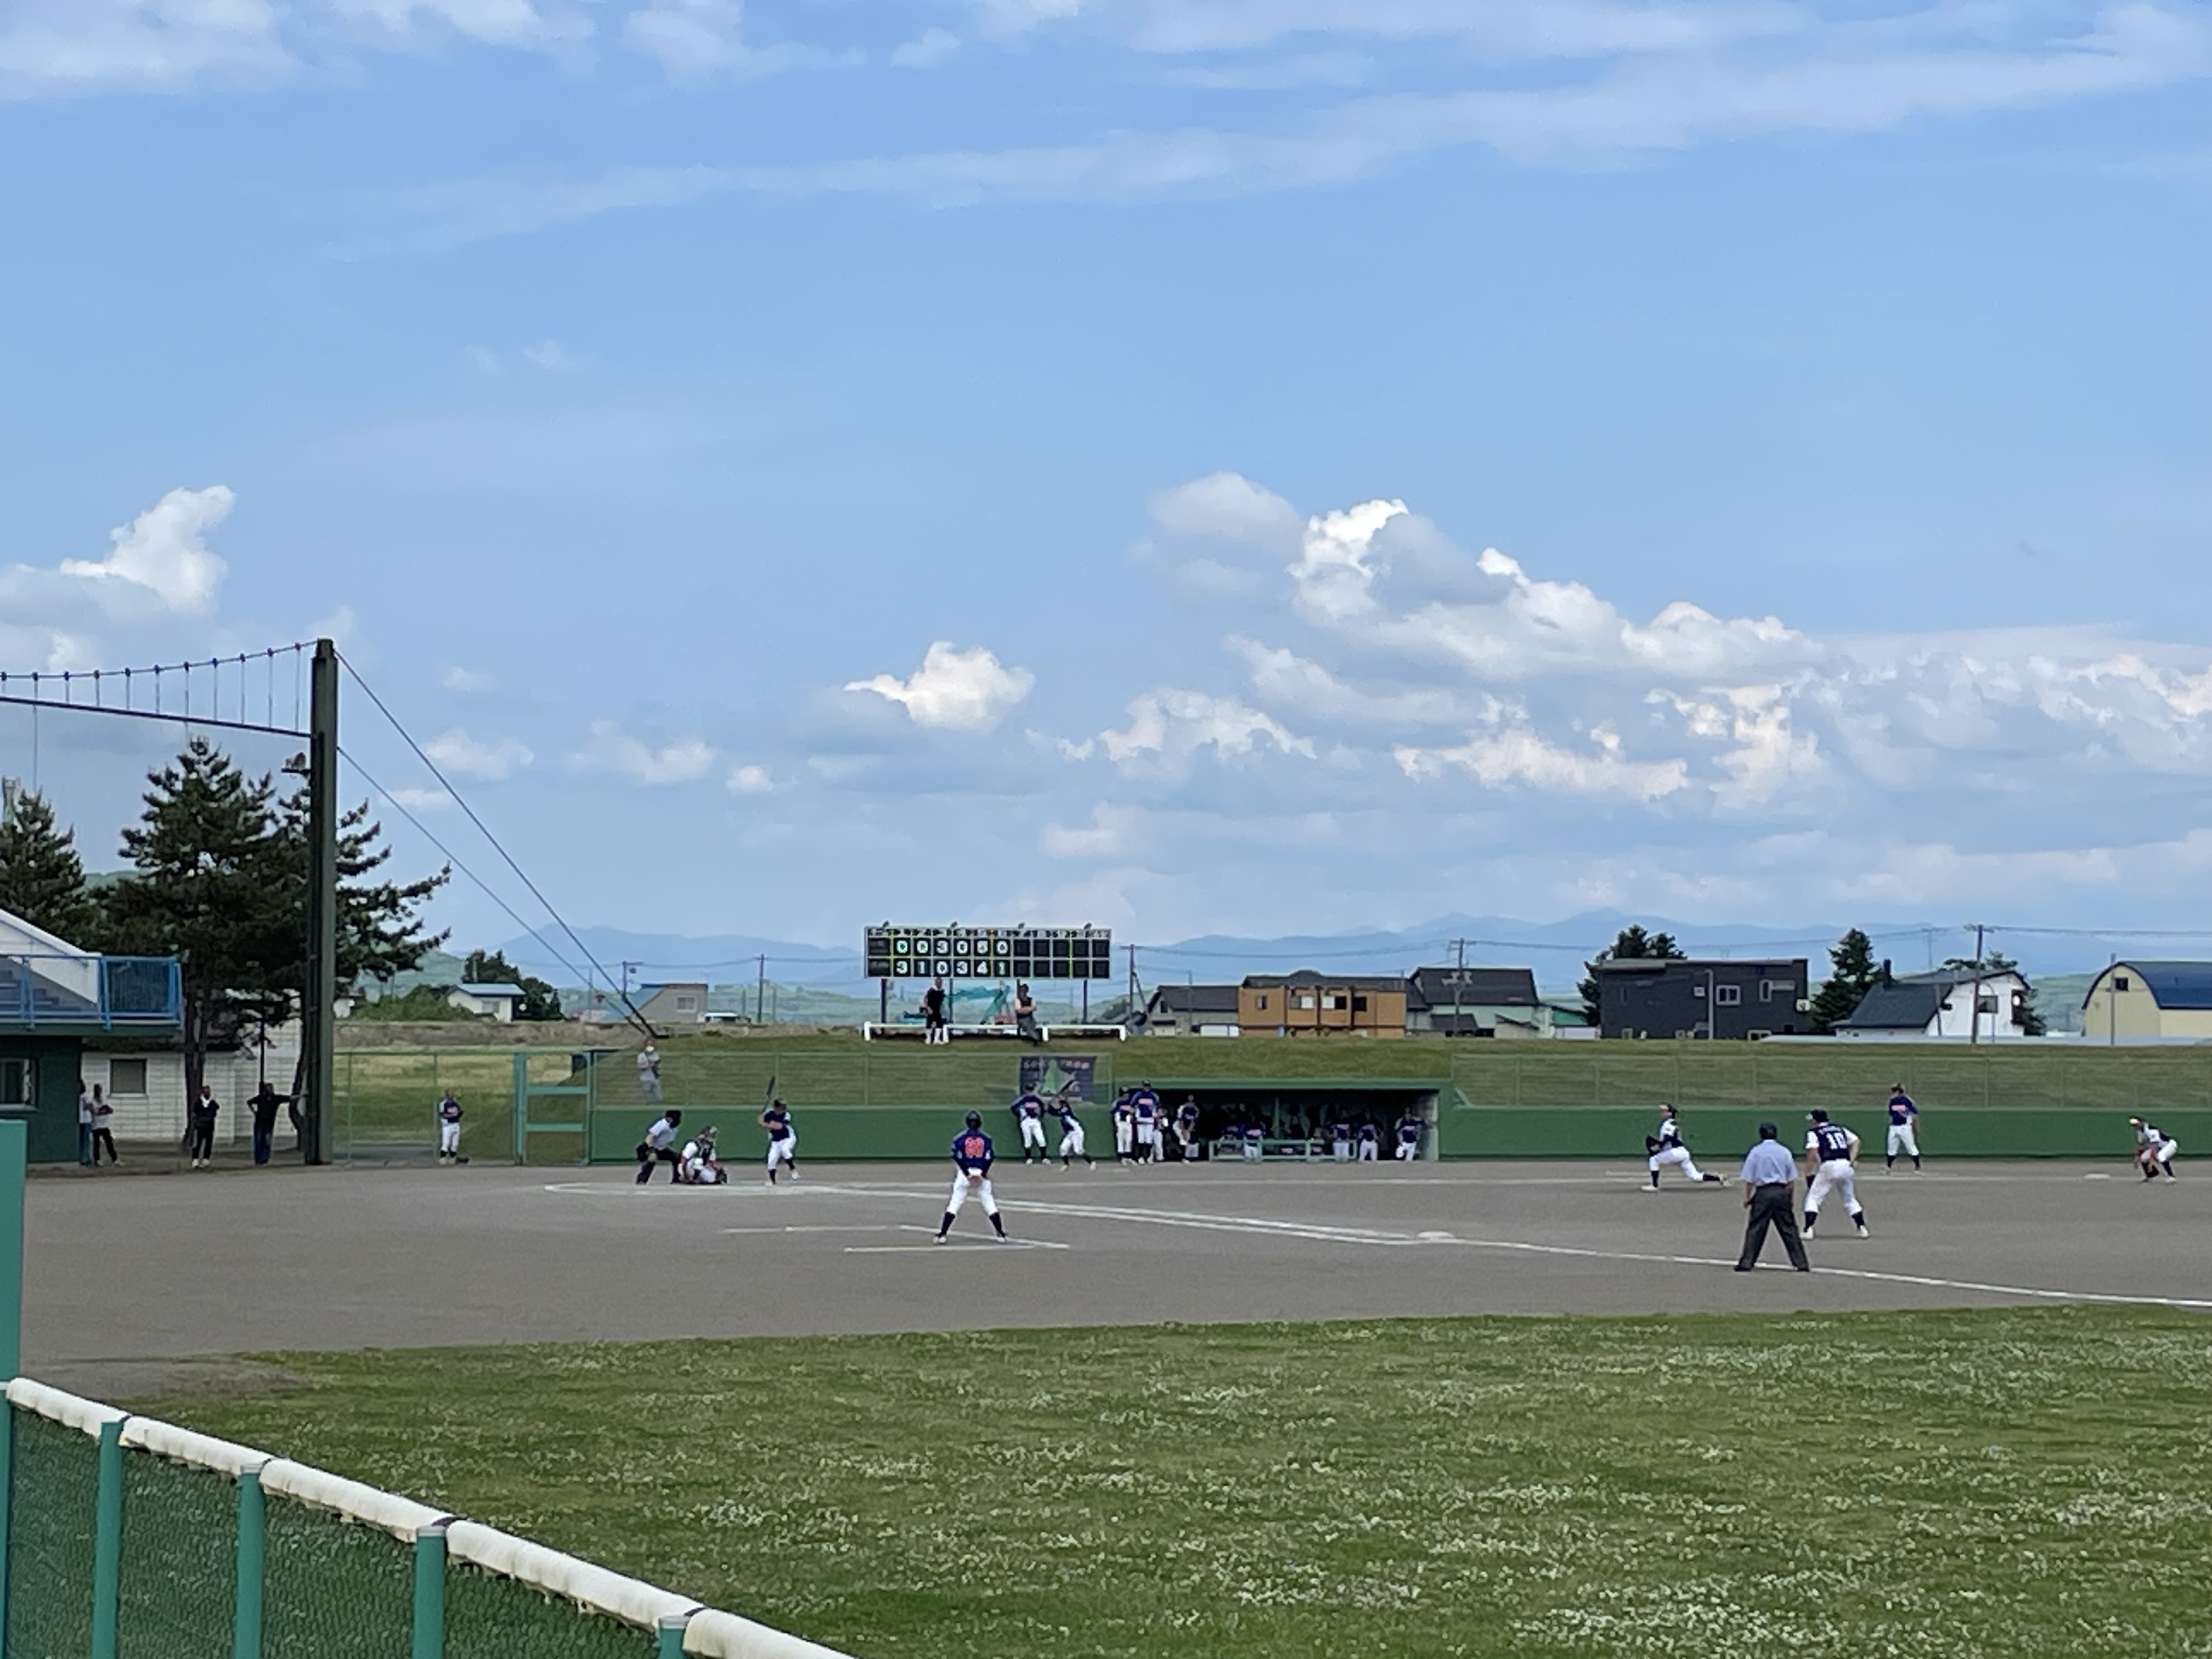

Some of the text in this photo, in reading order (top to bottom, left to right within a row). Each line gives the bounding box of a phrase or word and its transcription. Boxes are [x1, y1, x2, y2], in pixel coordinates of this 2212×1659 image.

[896, 940, 907, 953] 0
[936, 940, 949, 953] 3
[957, 940, 968, 954] 0
[997, 941, 1008, 954] 0
[896, 961, 907, 974] 3
[918, 961, 926, 974] 1
[936, 961, 949, 974] 0
[956, 961, 968, 974] 3
[977, 961, 988, 974] 4
[998, 962, 1006, 975] 1
